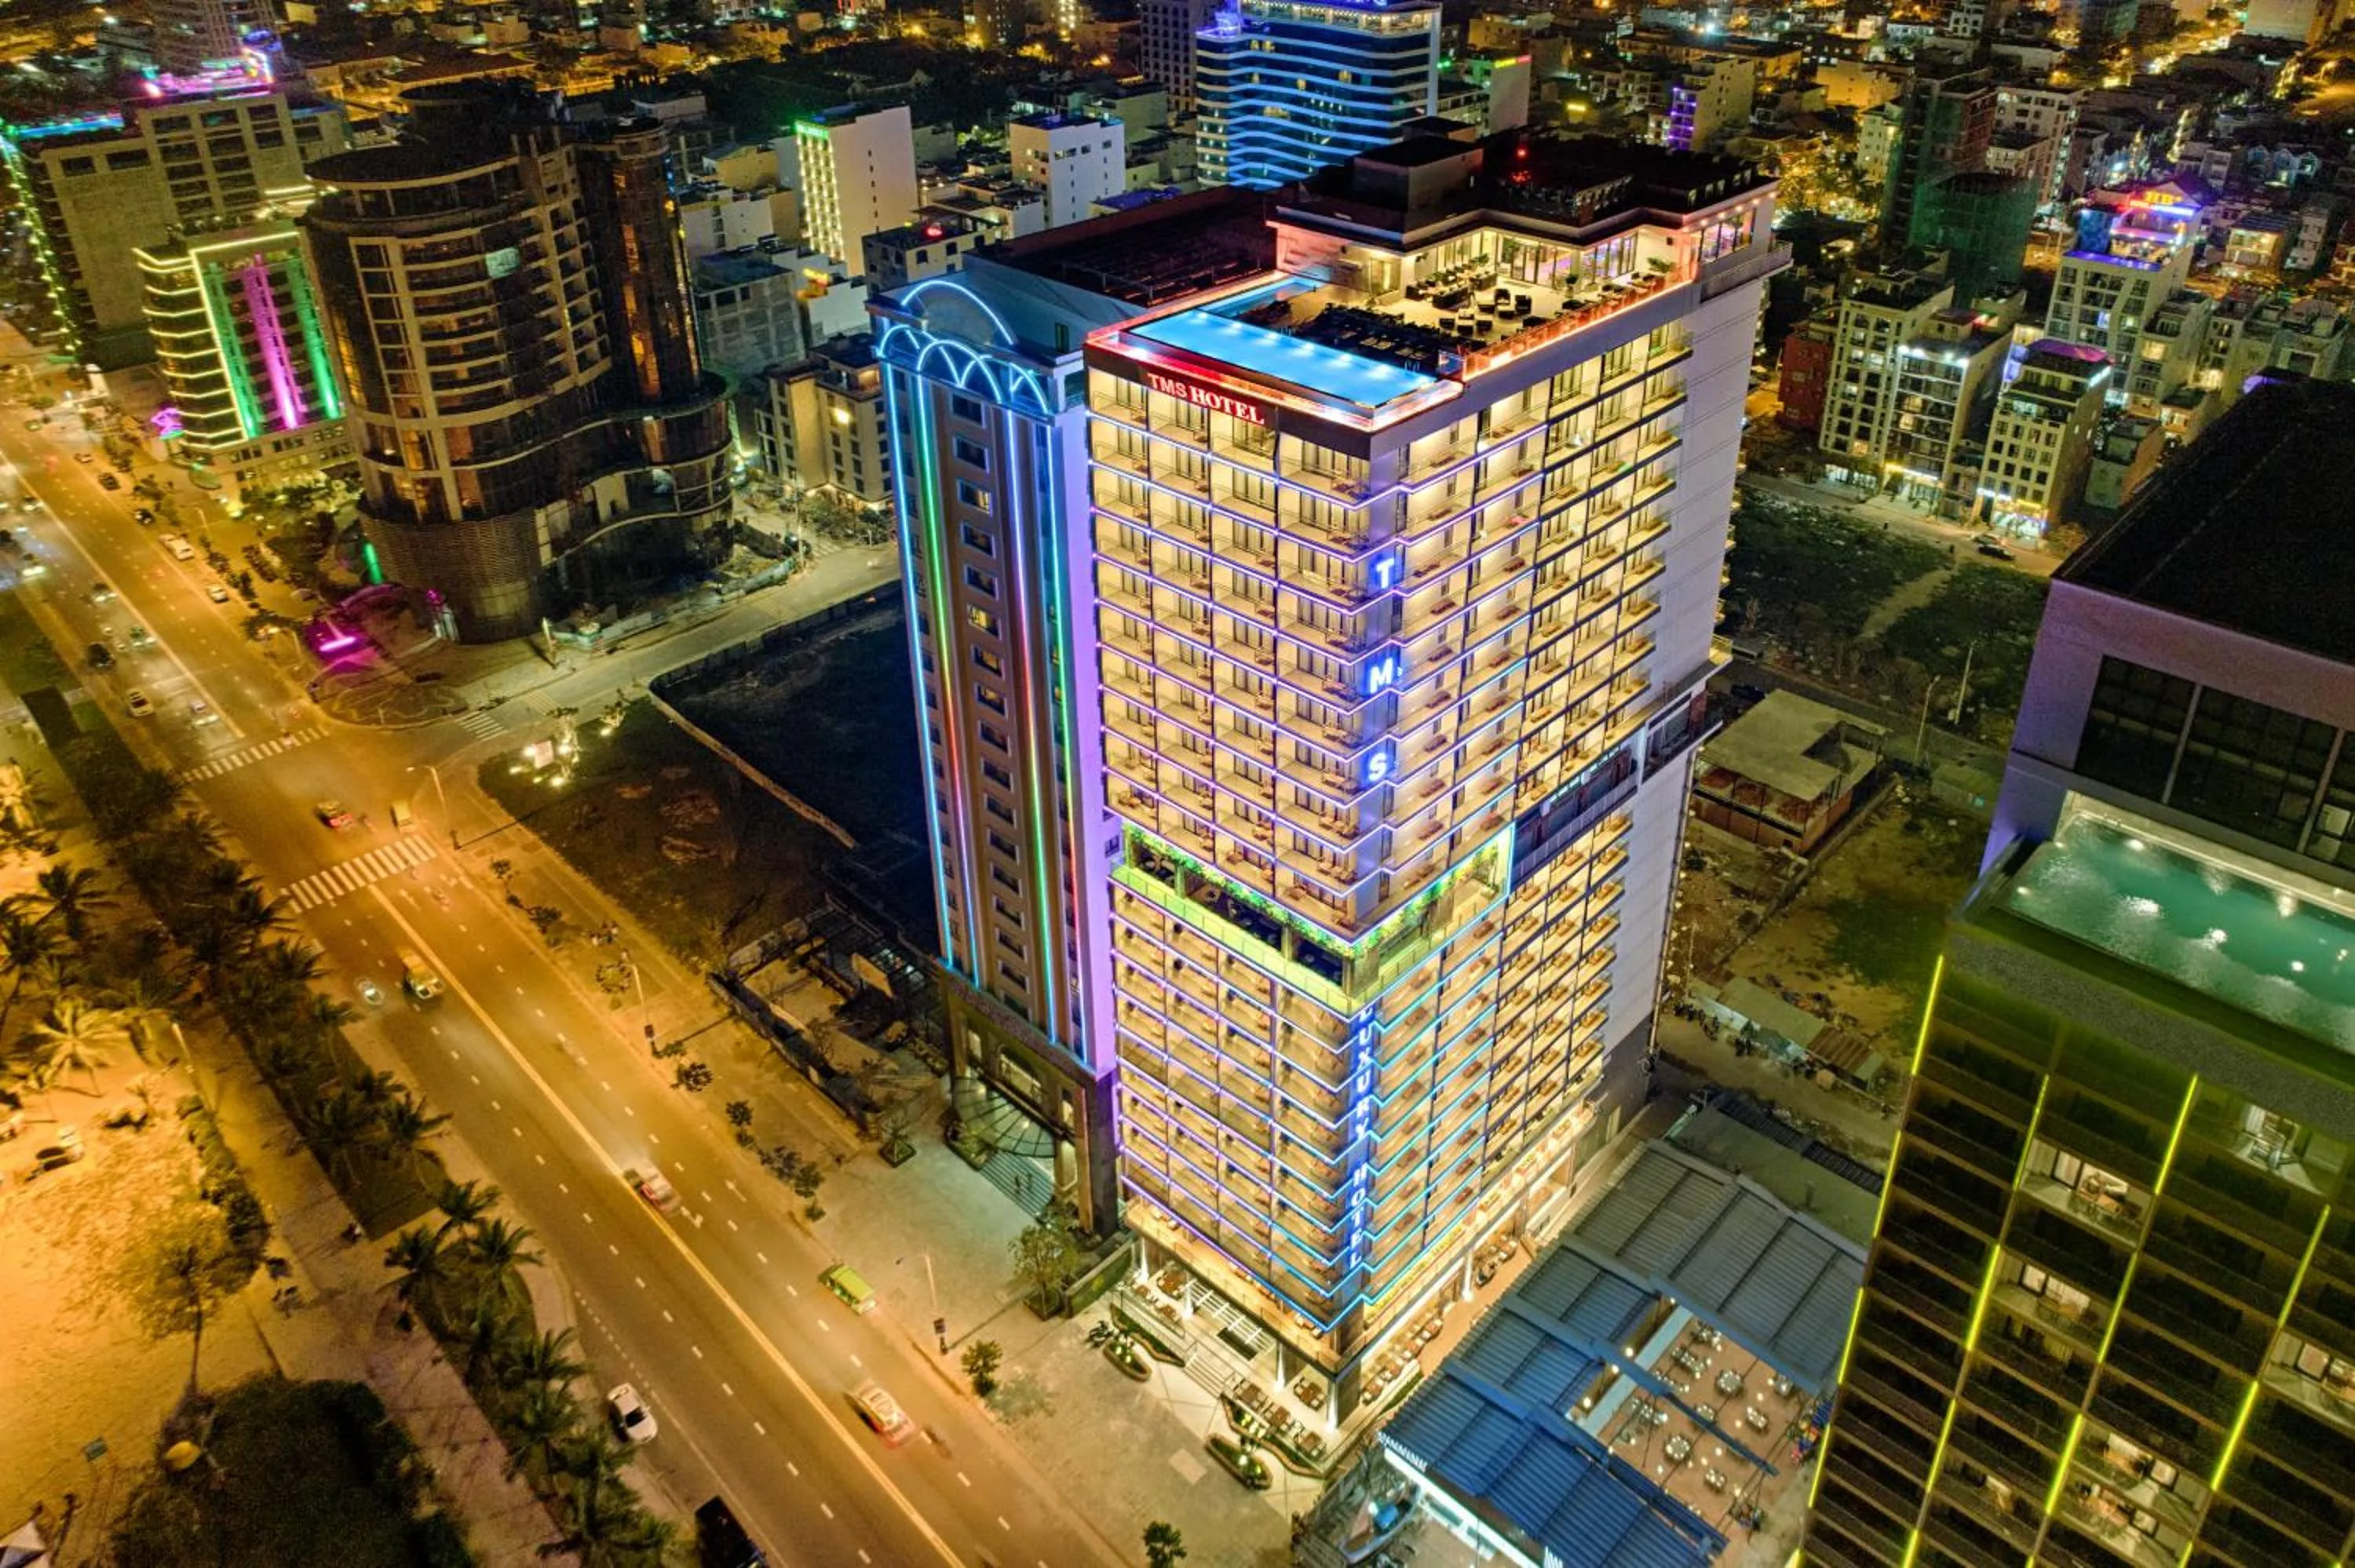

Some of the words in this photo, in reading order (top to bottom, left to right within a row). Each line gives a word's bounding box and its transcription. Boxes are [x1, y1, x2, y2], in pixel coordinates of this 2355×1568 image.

[1148, 373, 1187, 398] TMS
[1189, 386, 1265, 425] HOTEL
[1356, 1007, 1374, 1141] LUXURY
[1350, 1162, 1367, 1269] HOTEL
